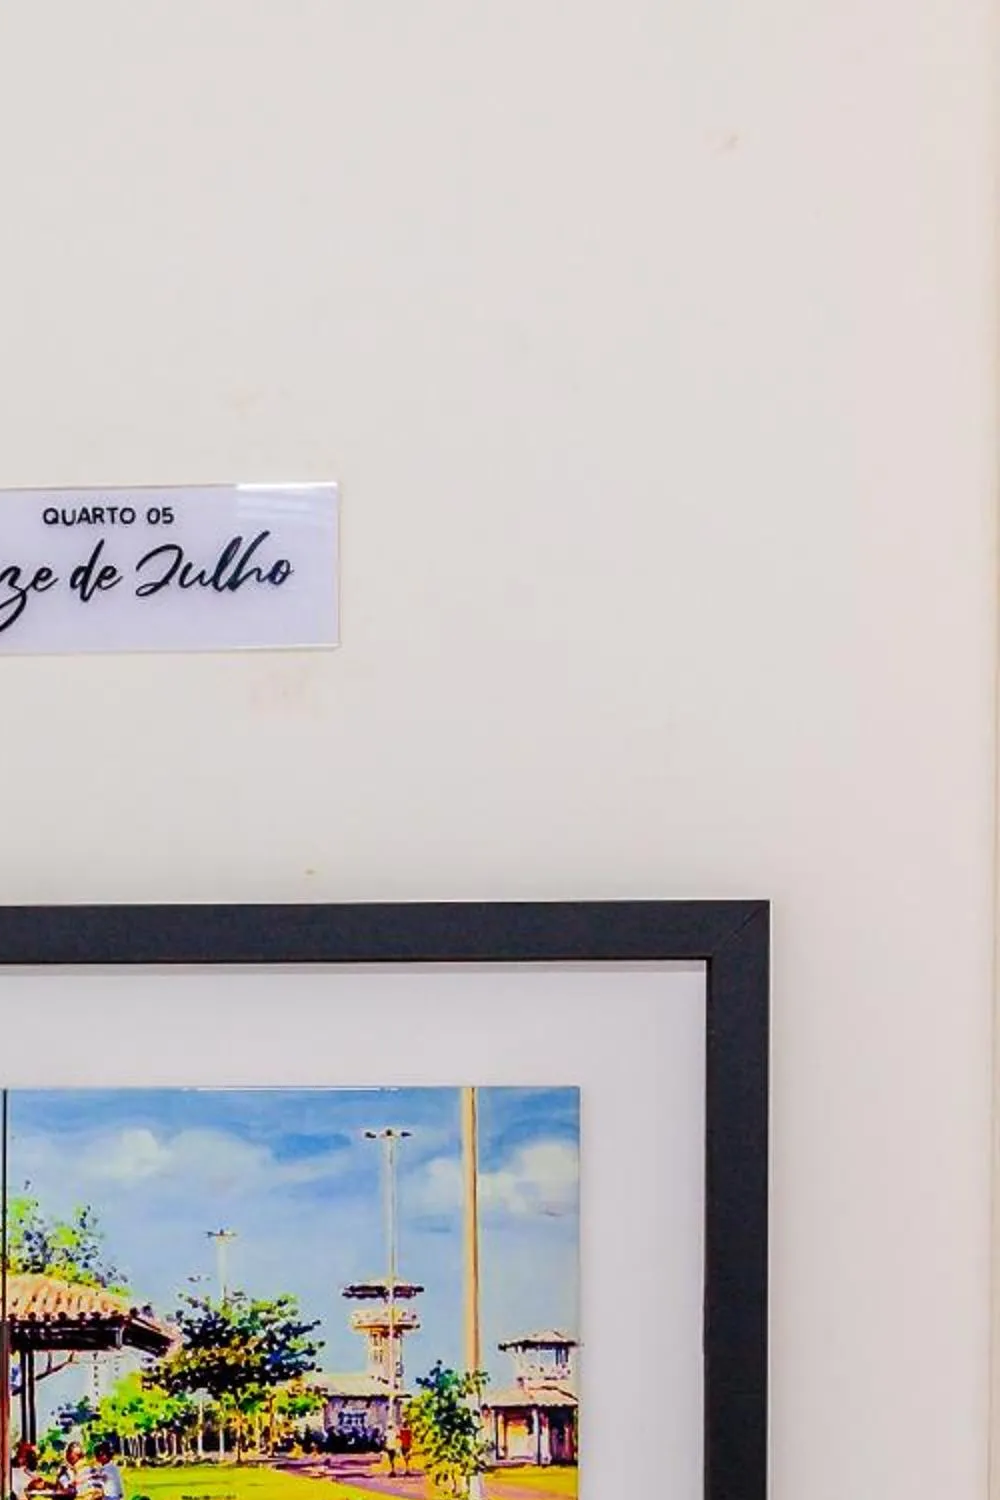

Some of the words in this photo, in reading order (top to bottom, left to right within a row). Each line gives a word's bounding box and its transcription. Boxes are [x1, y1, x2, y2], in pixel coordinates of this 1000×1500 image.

[42, 506, 137, 527] QUARTO
[146, 506, 175, 526] 05
[68, 538, 124, 603] de
[135, 530, 295, 598] Julho
